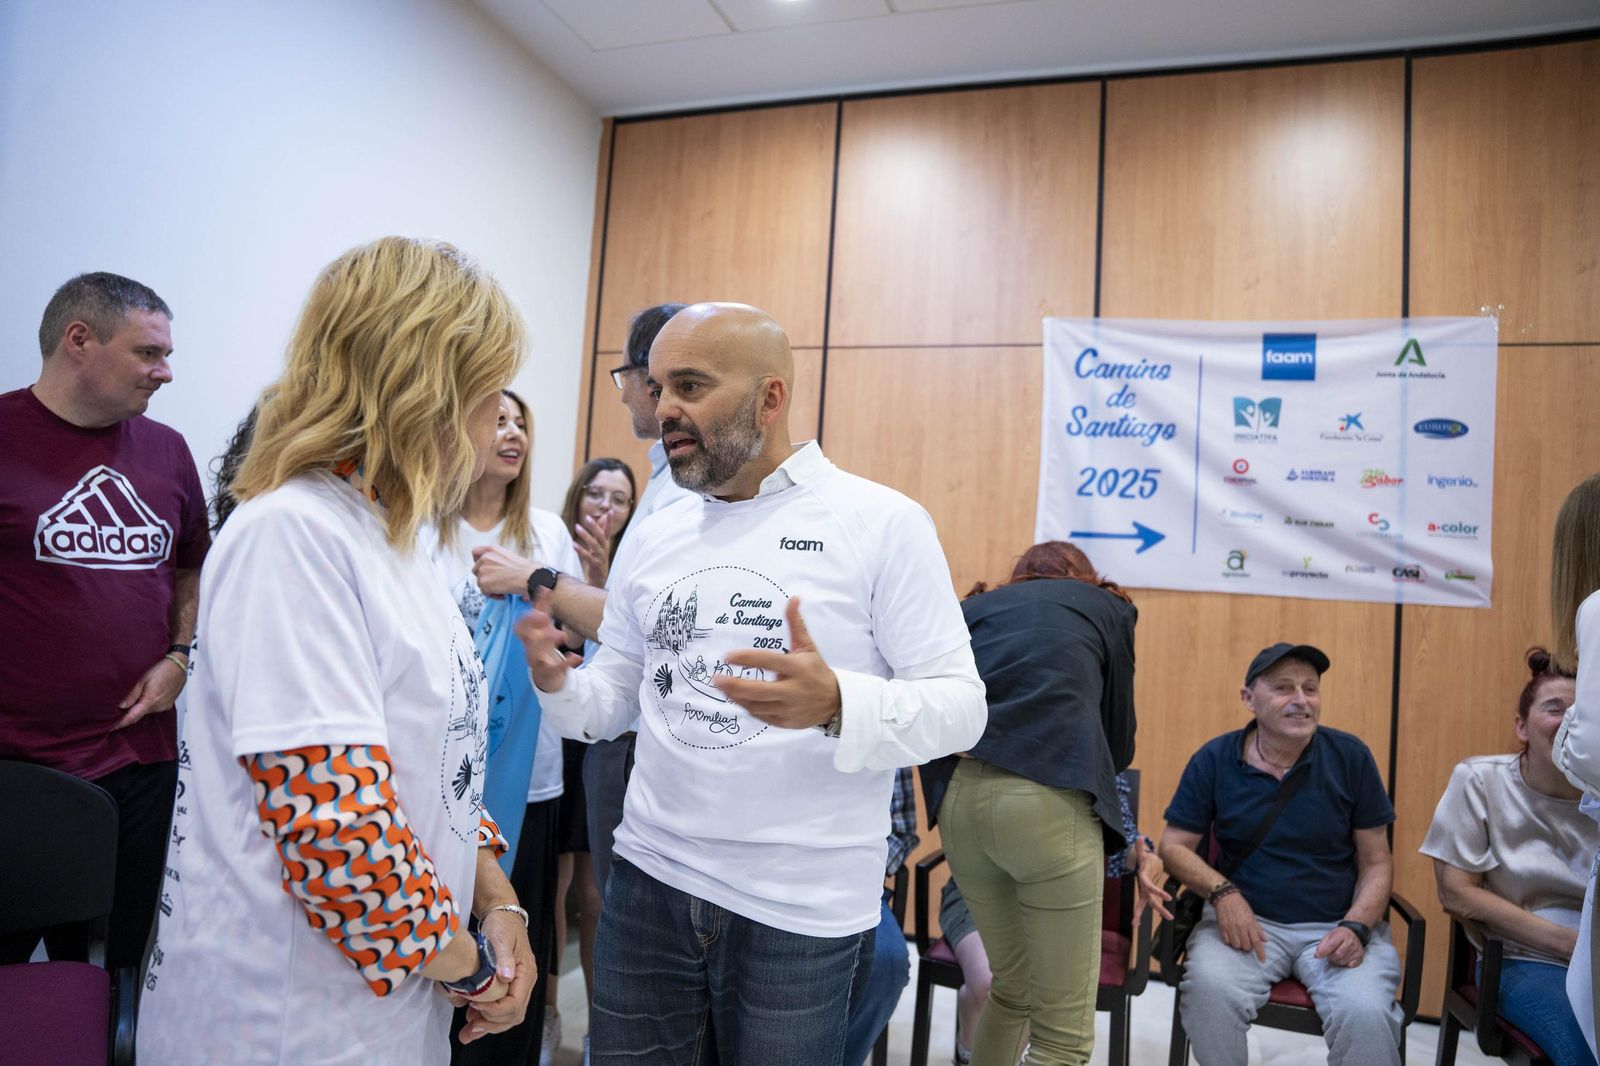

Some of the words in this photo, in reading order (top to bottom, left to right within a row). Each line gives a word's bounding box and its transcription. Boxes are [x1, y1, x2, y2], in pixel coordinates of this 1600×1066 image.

[1074, 347, 1172, 380] Camino
[1265, 348, 1313, 364] faam
[1105, 384, 1137, 409] de
[1065, 405, 1177, 448] Santiago
[1075, 466, 1162, 500] 2025
[50, 525, 163, 556] adidas
[779, 536, 824, 552] faam
[729, 592, 773, 609] Camino
[714, 612, 730, 626] de
[732, 609, 783, 631] Santiago
[752, 635, 784, 650] 2025
